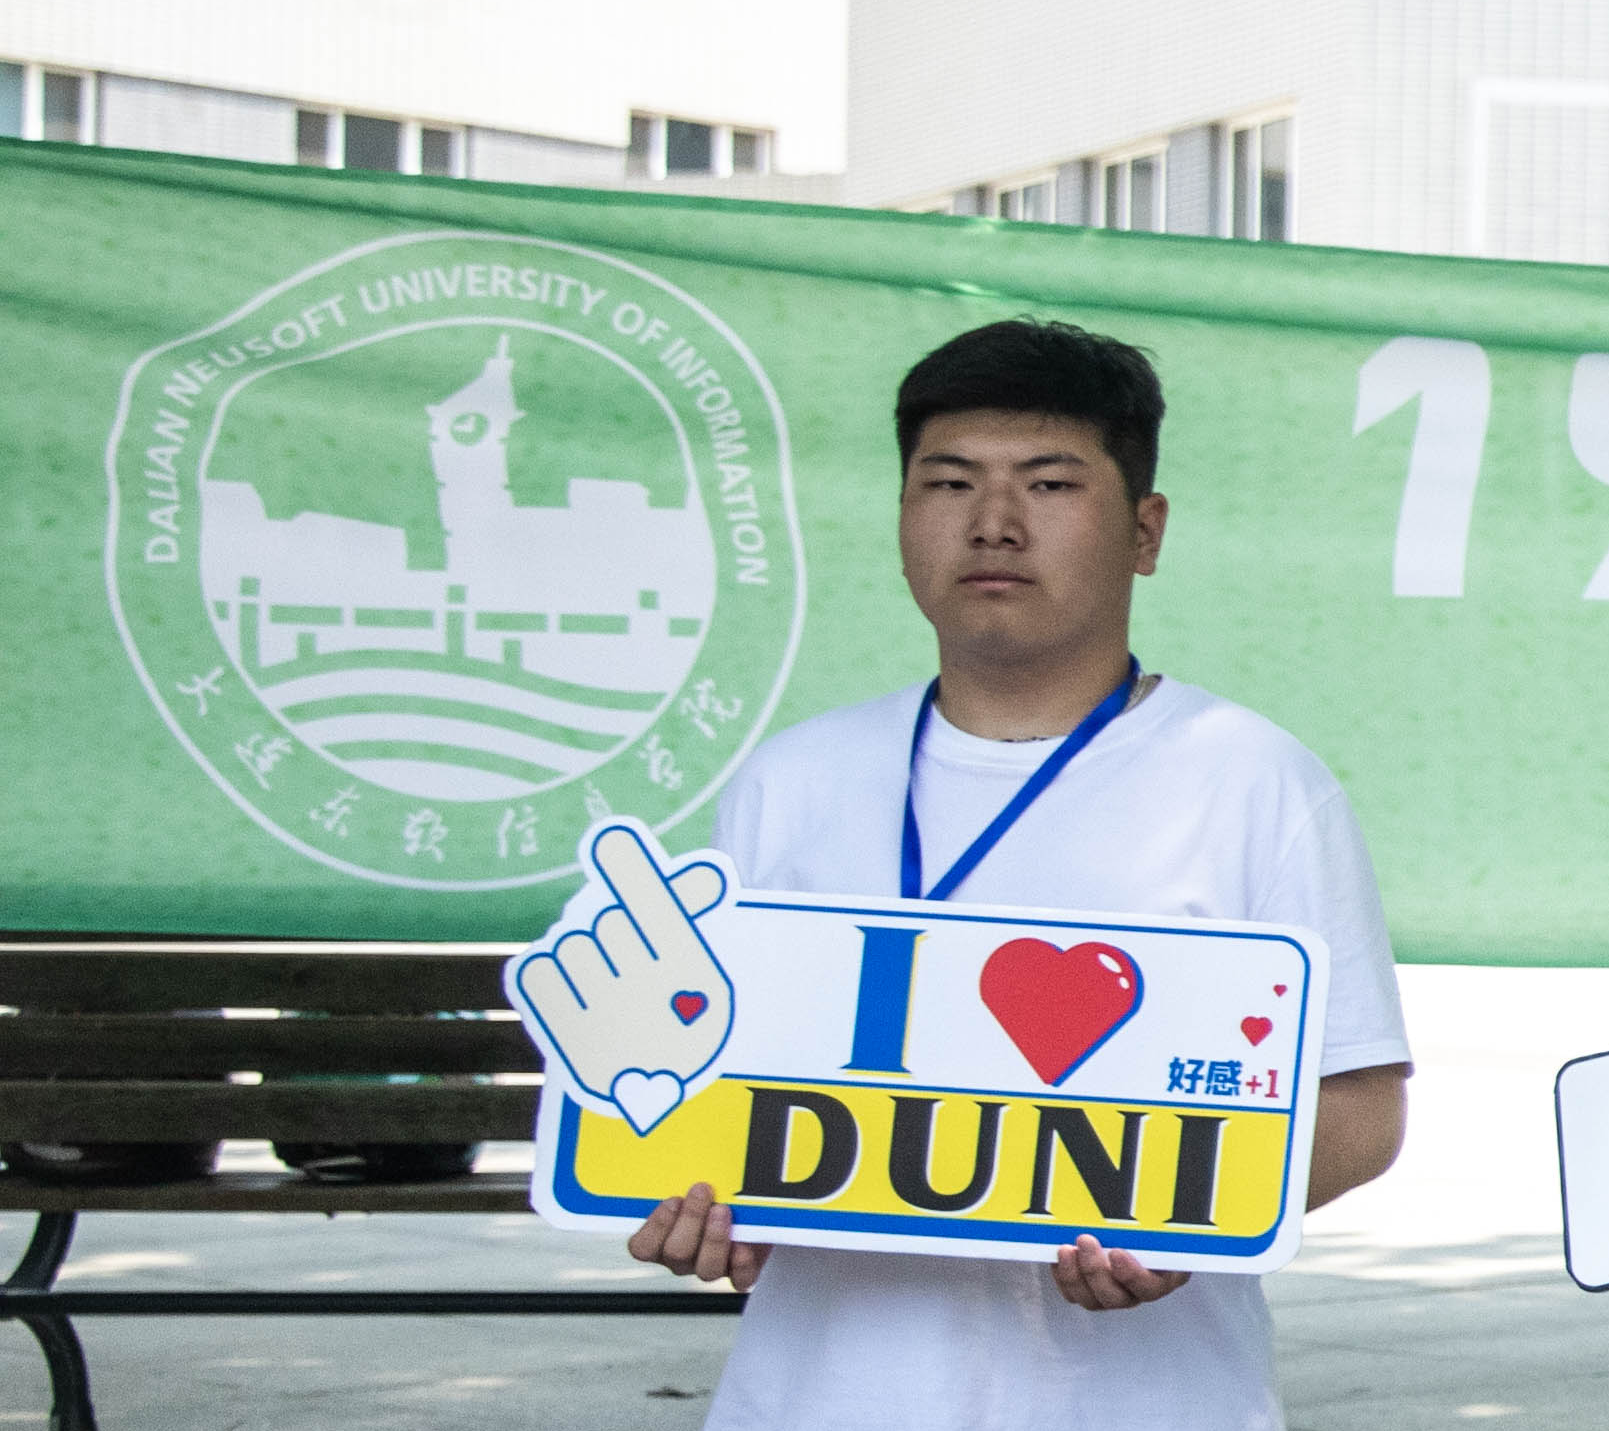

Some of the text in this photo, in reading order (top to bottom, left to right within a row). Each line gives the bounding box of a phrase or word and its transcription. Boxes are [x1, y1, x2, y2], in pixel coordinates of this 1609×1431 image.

[144, 263, 770, 587] DALIAN NEUSOFT UNIVERSITY OF INFORMATION
[840, 925, 927, 1076] I
[734, 1086, 1230, 1229] DUNI
